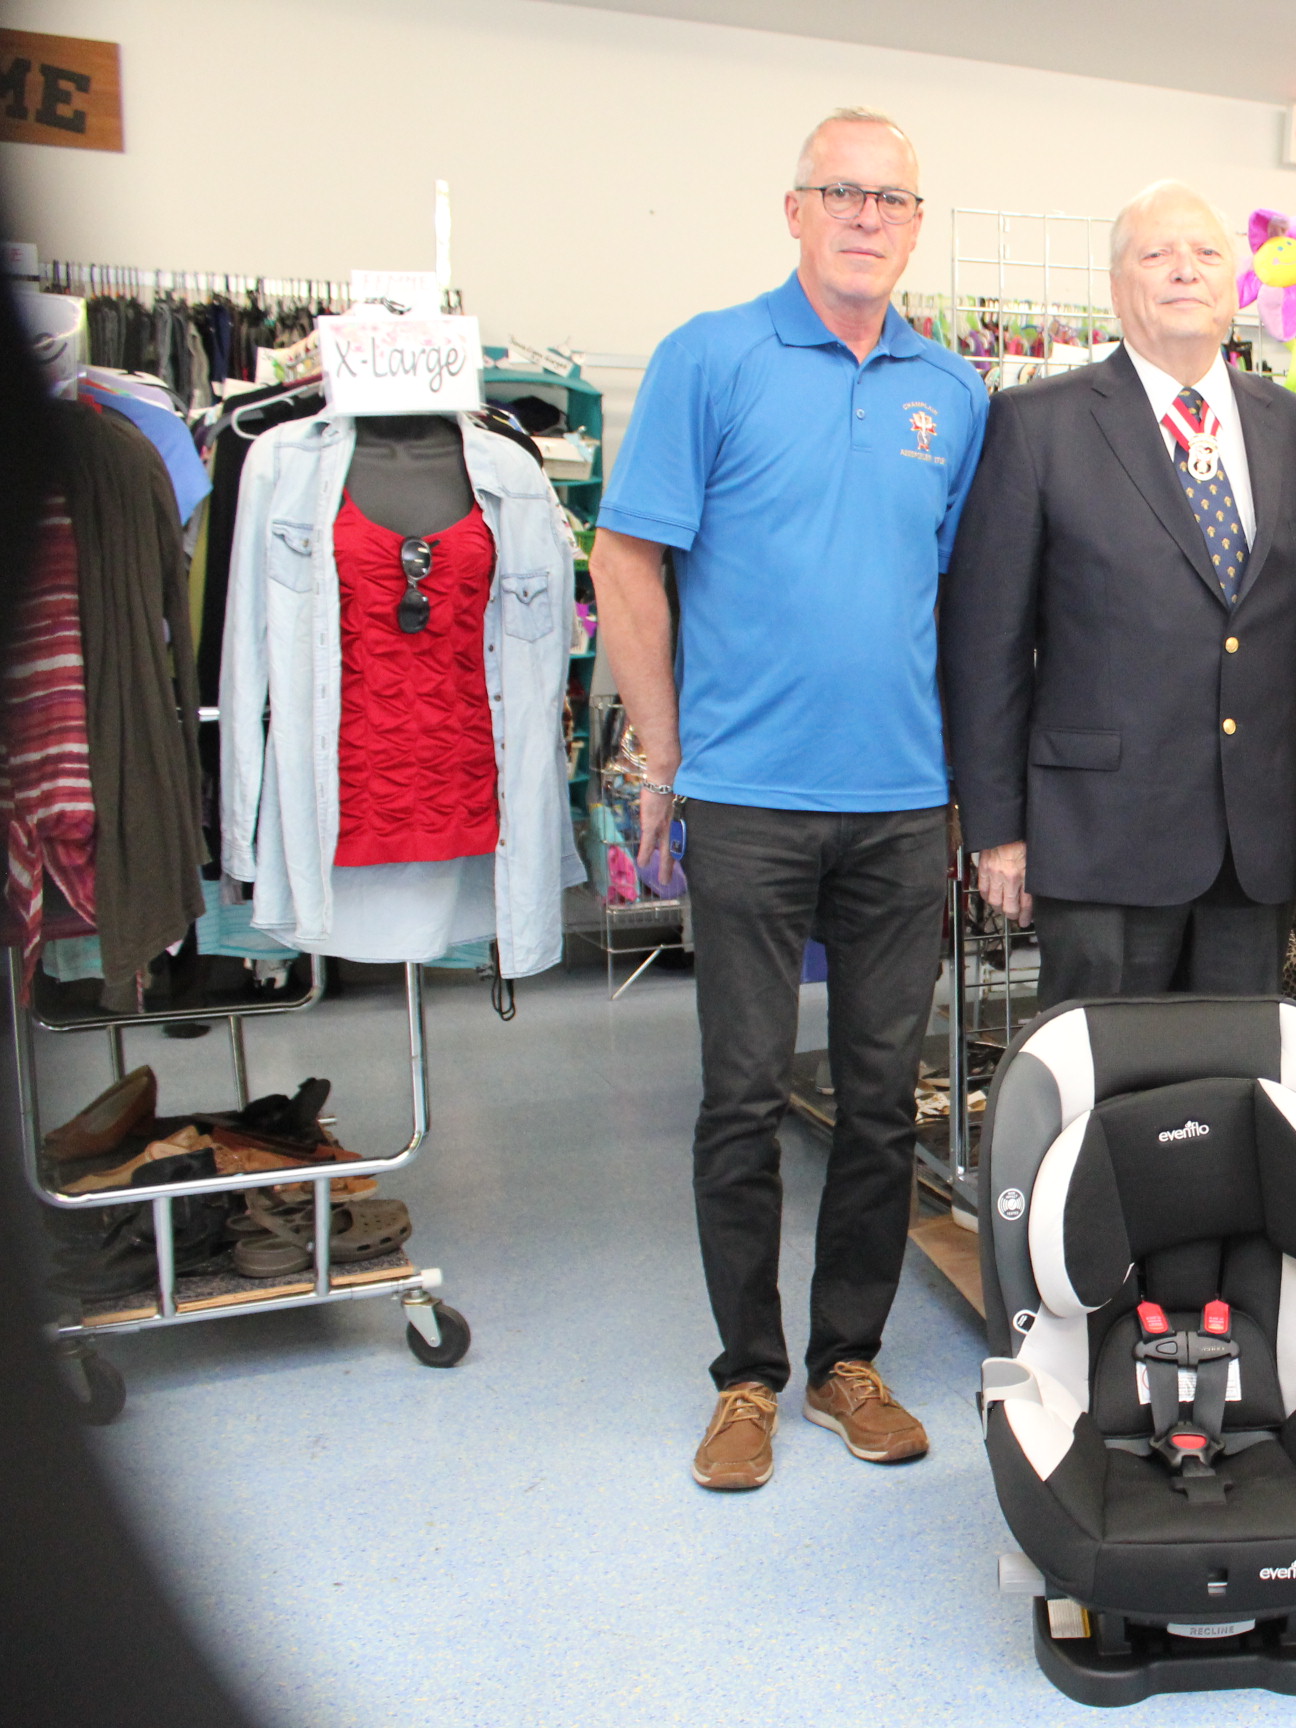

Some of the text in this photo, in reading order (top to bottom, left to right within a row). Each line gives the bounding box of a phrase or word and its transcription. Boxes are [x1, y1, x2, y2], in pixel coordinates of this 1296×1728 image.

[335, 336, 466, 393] X-Large
[1158, 1120, 1210, 1142] evenflo
[1189, 1625, 1235, 1636] RECLINE
